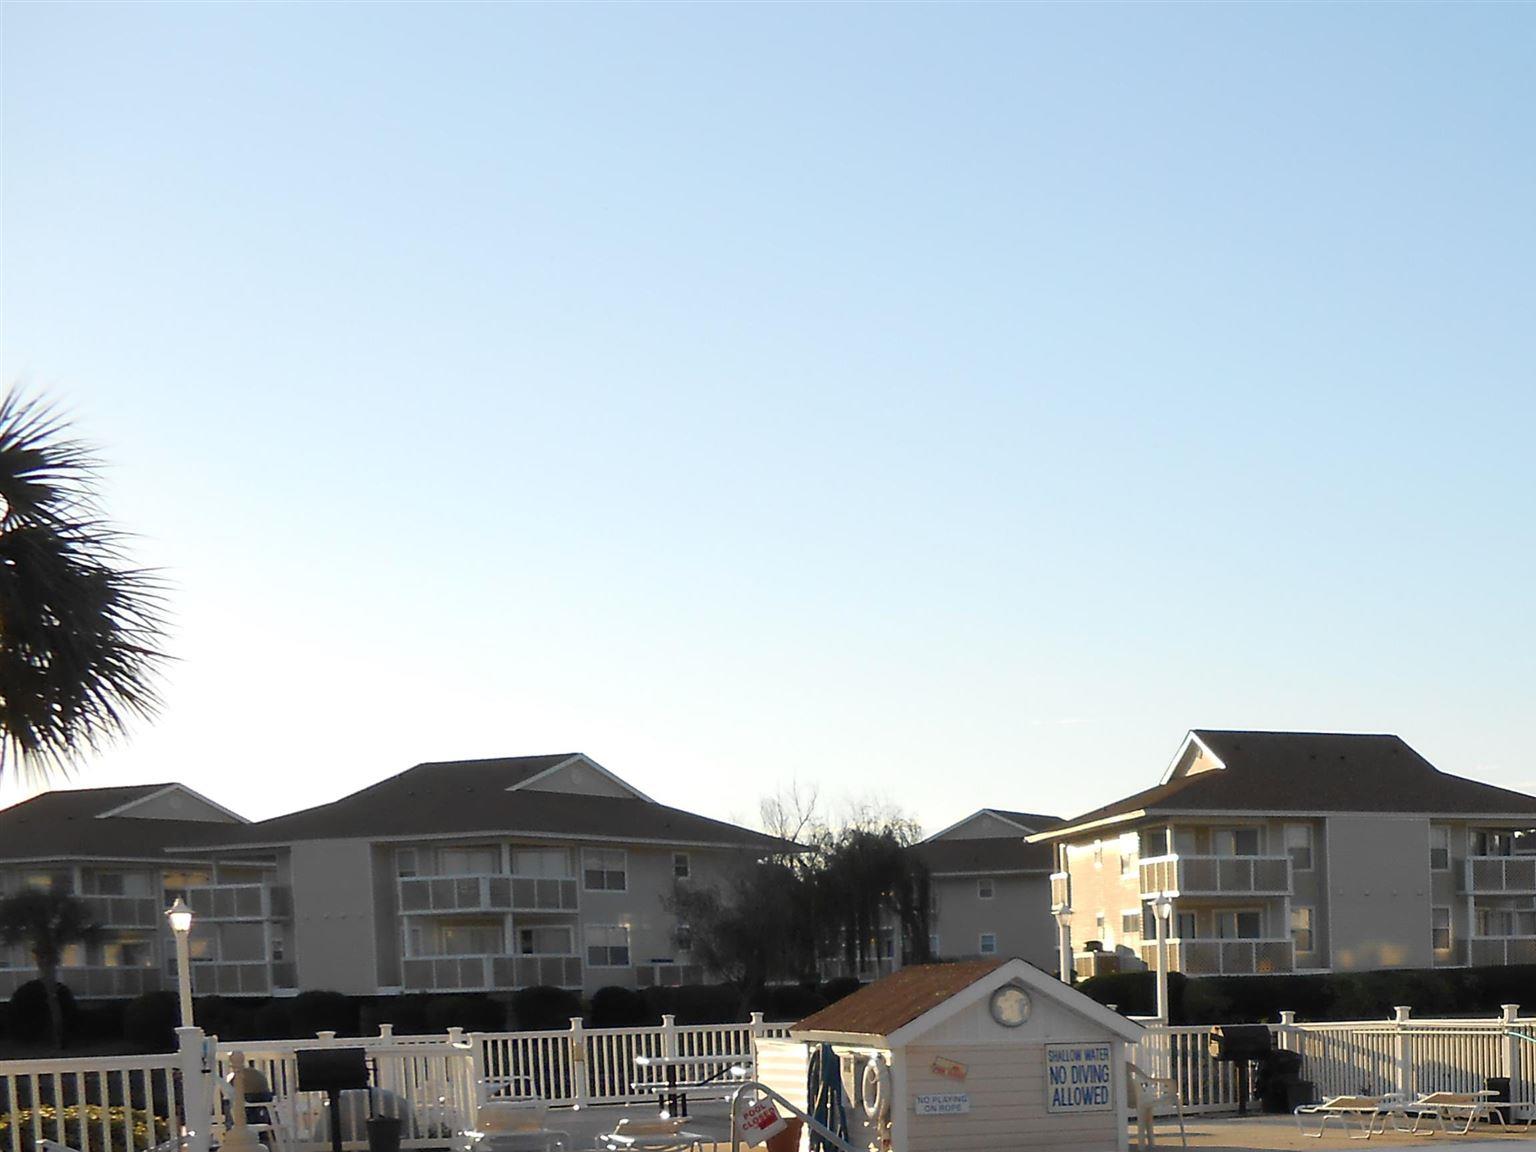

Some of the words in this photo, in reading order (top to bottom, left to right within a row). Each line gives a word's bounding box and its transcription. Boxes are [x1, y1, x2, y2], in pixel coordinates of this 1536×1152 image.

[1048, 1049, 1081, 1062] SHALLOW
[1085, 1047, 1109, 1061] WATER
[1050, 1065, 1067, 1085] NO
[1072, 1064, 1109, 1084] DIVING
[1052, 1085, 1109, 1107] ALLOWED
